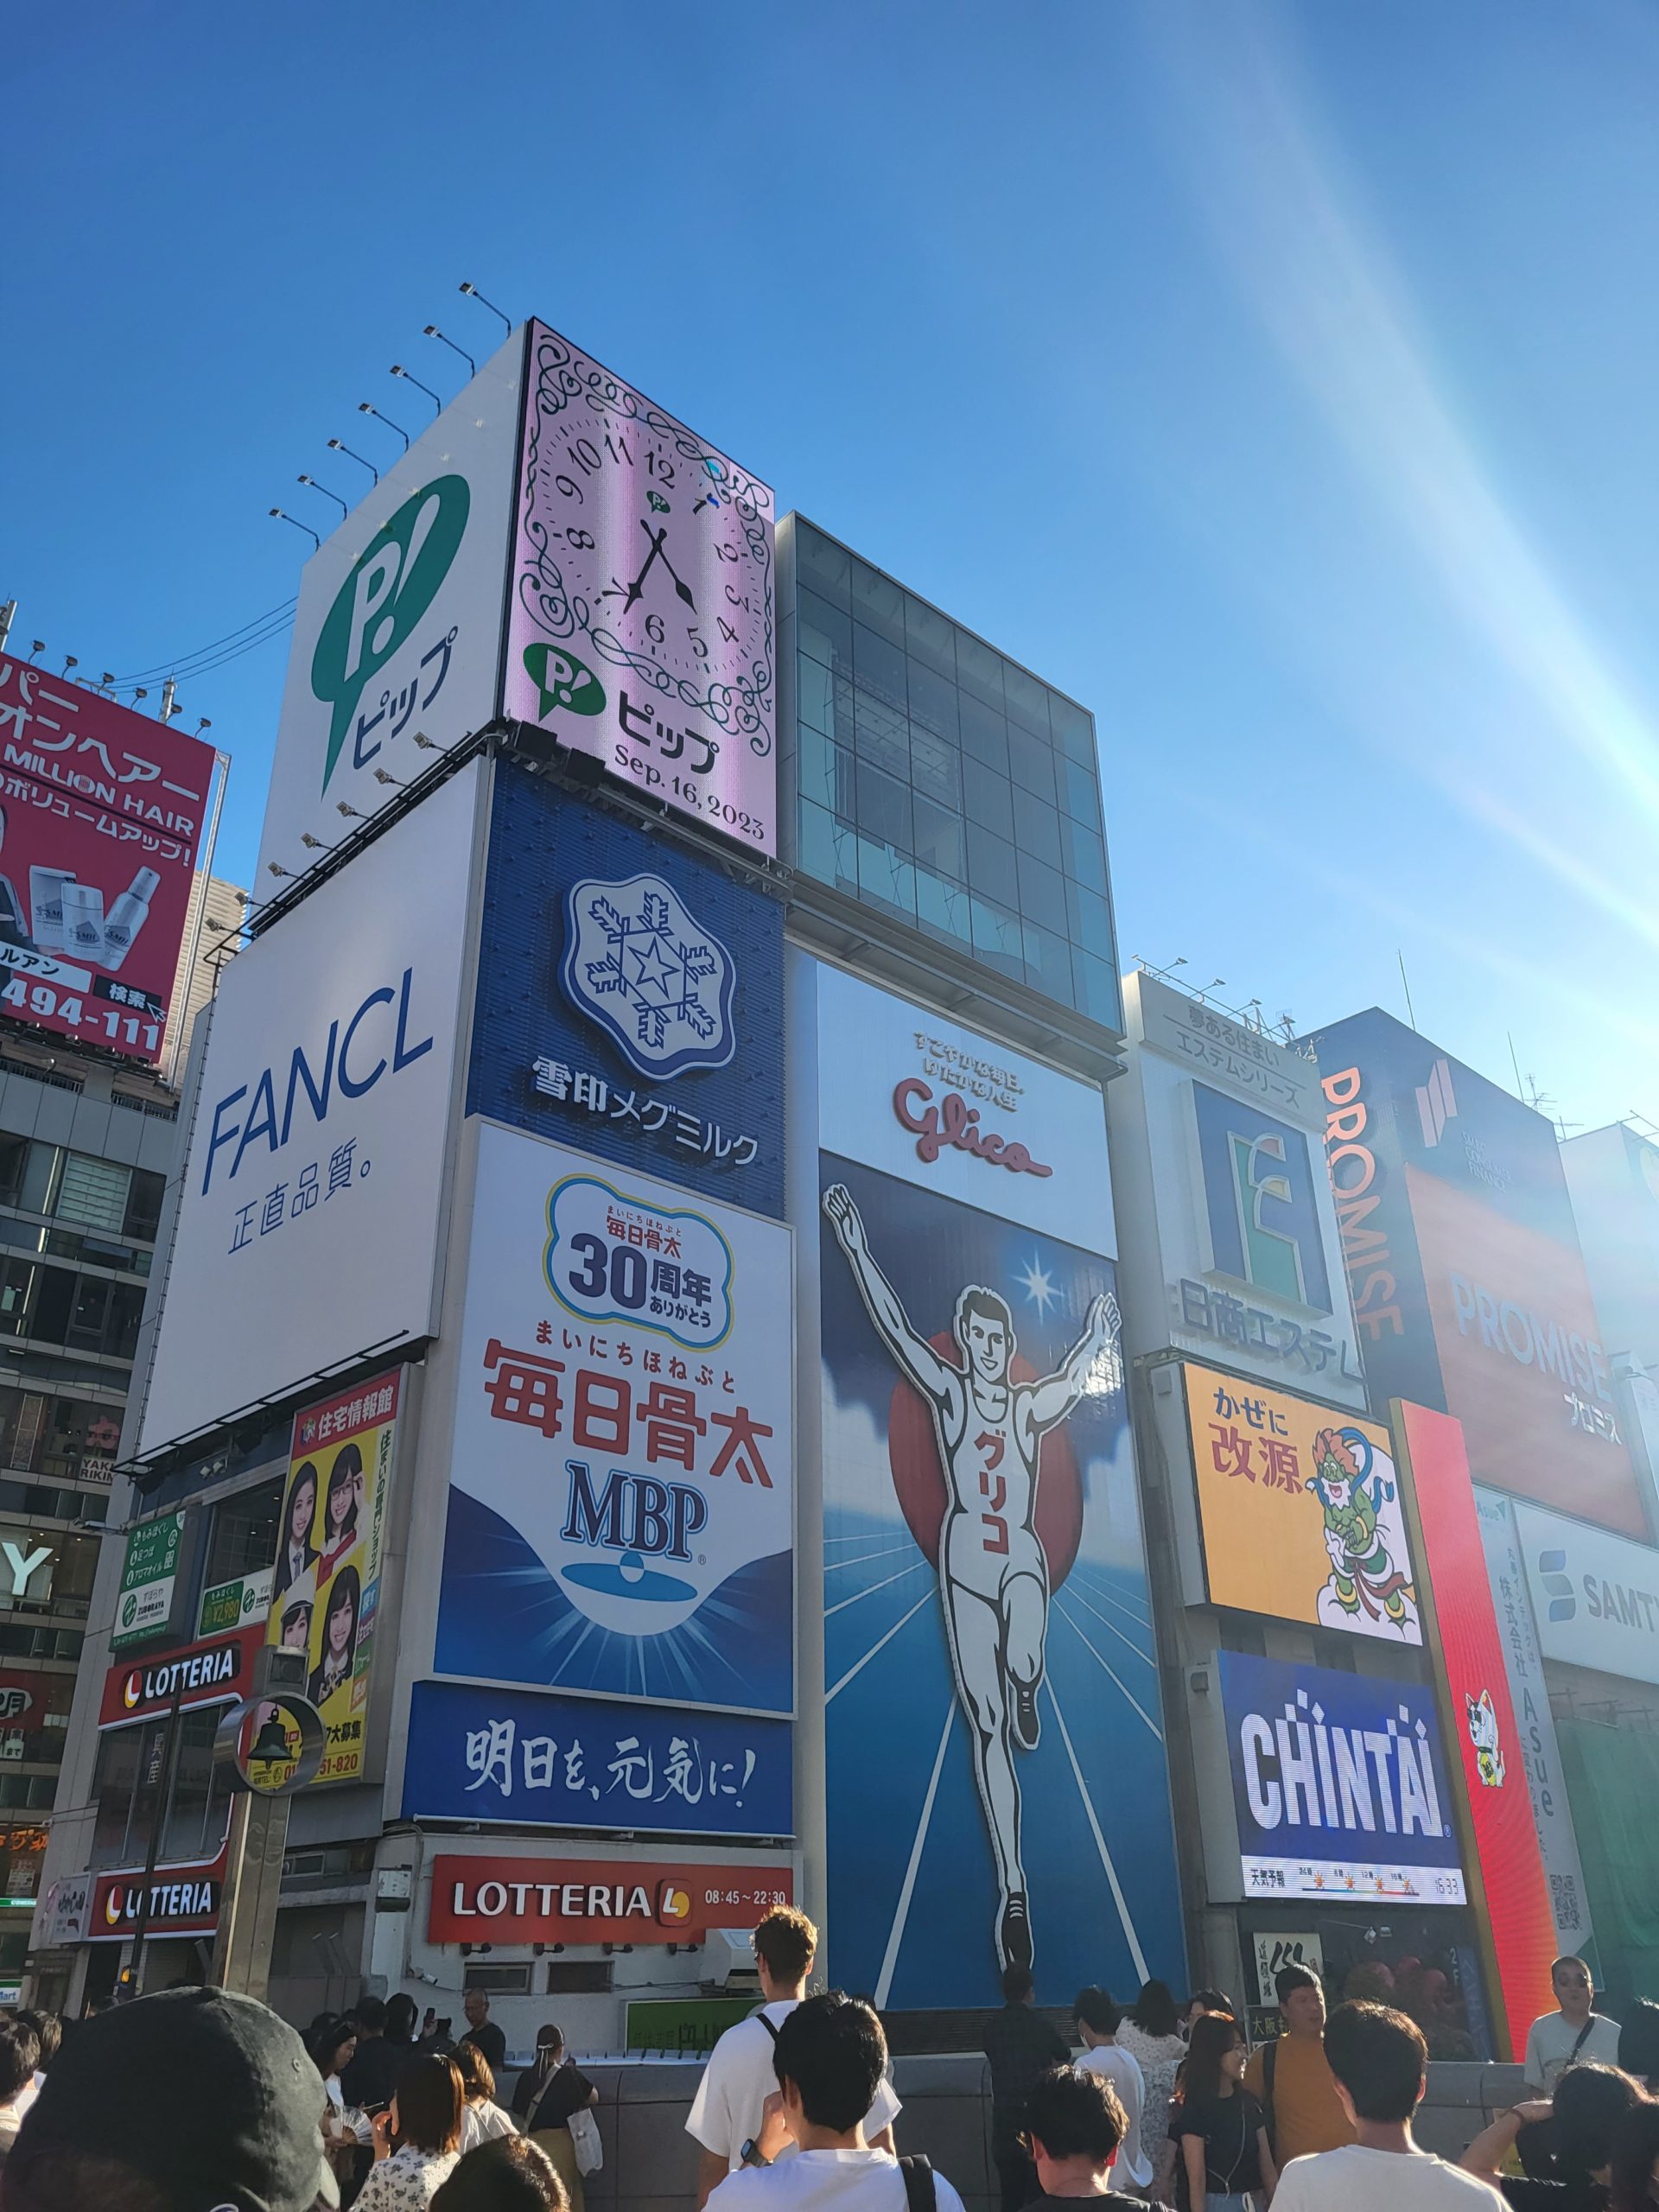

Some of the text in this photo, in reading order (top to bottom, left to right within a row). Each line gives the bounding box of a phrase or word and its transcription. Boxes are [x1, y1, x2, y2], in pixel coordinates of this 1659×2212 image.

[566, 438, 602, 476] 10
[604, 434, 634, 467] 11
[644, 451, 676, 490] 12
[555, 474, 584, 505] 9
[566, 527, 595, 550] 8
[713, 542, 739, 563] 2
[724, 584, 750, 613] 3
[645, 613, 665, 644] 6
[686, 626, 709, 658] 5
[716, 616, 740, 643] 4
[353, 625, 459, 770] ピップ
[618, 689, 721, 775] ピップ
[3, 743, 195, 837] MILLION HAIR
[614, 744, 766, 842] Sep. 16, 2023
[0, 772, 191, 868] ボリュームアップ!
[1, 977, 160, 1052] 494-111
[109, 982, 147, 1009] 検索
[201, 966, 435, 1198] FANCL
[531, 1054, 760, 1166] 雪印メグミルク
[893, 1077, 1054, 1179] Glico
[227, 1136, 372, 1255] 正直品質。
[606, 1215, 683, 1260] 毎日骨太
[649, 1295, 712, 1329] ありがとう
[1450, 1270, 1614, 1403] PROMISE
[535, 1319, 735, 1395] まいにちほねぶと
[316, 1384, 395, 1441] 住宅情報館
[483, 1337, 773, 1489] 毎日骨太
[1213, 1386, 1289, 1436] かぜに
[1563, 1392, 1623, 1446] プロミス
[1207, 1422, 1304, 1495] 改源
[560, 1459, 709, 1561] MBP
[973, 1428, 1010, 1556] グリコ
[1, 1541, 54, 1596] Y
[1582, 1573, 1659, 1633] SAMT
[145, 1648, 233, 1699] LOTTERIA
[464, 1718, 757, 1808] 明日を、元気に!
[1240, 1688, 1445, 1838] CHINTAI
[453, 1881, 653, 1918] LOTTERIA
[1250, 1869, 1286, 1887] 天気予報
